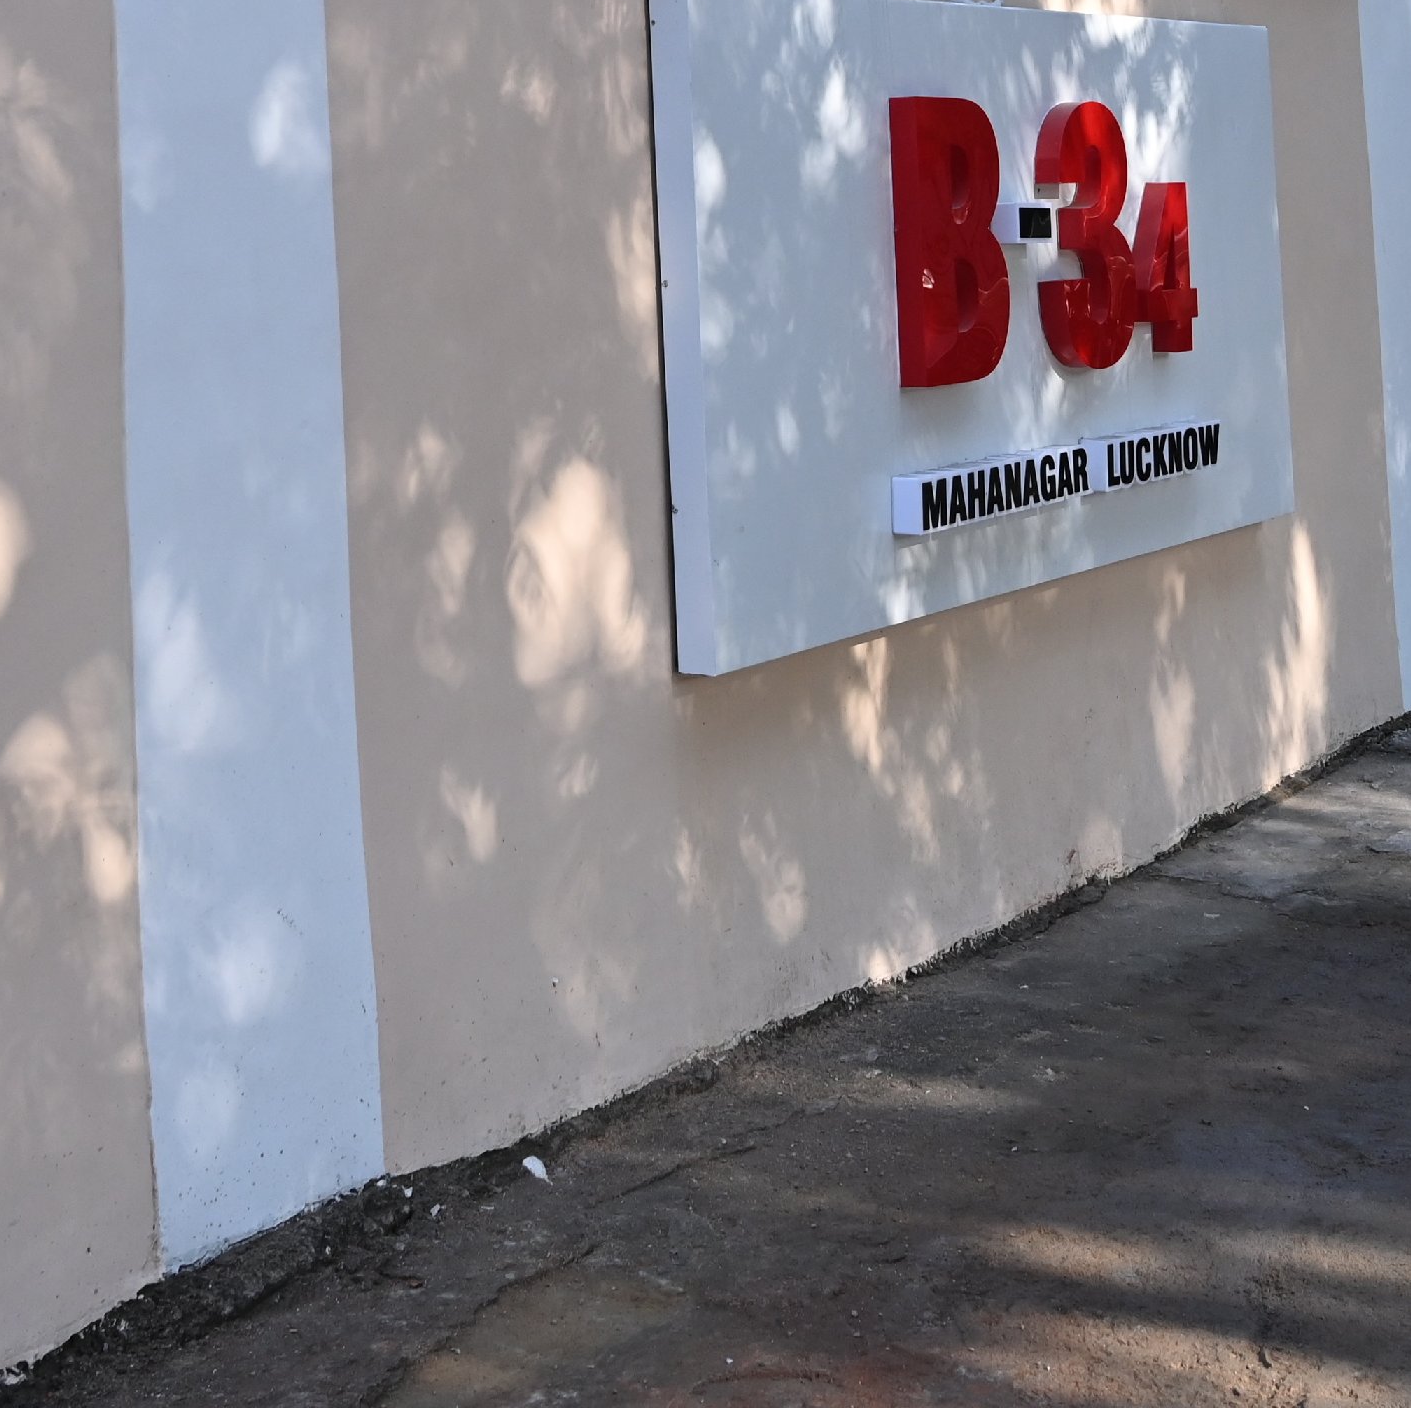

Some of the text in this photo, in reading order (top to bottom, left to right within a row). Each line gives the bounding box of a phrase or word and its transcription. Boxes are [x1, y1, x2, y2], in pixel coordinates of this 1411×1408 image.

[889, 96, 1198, 388] B-34
[922, 424, 1220, 531] MAHANAGAR LUCKNOW
